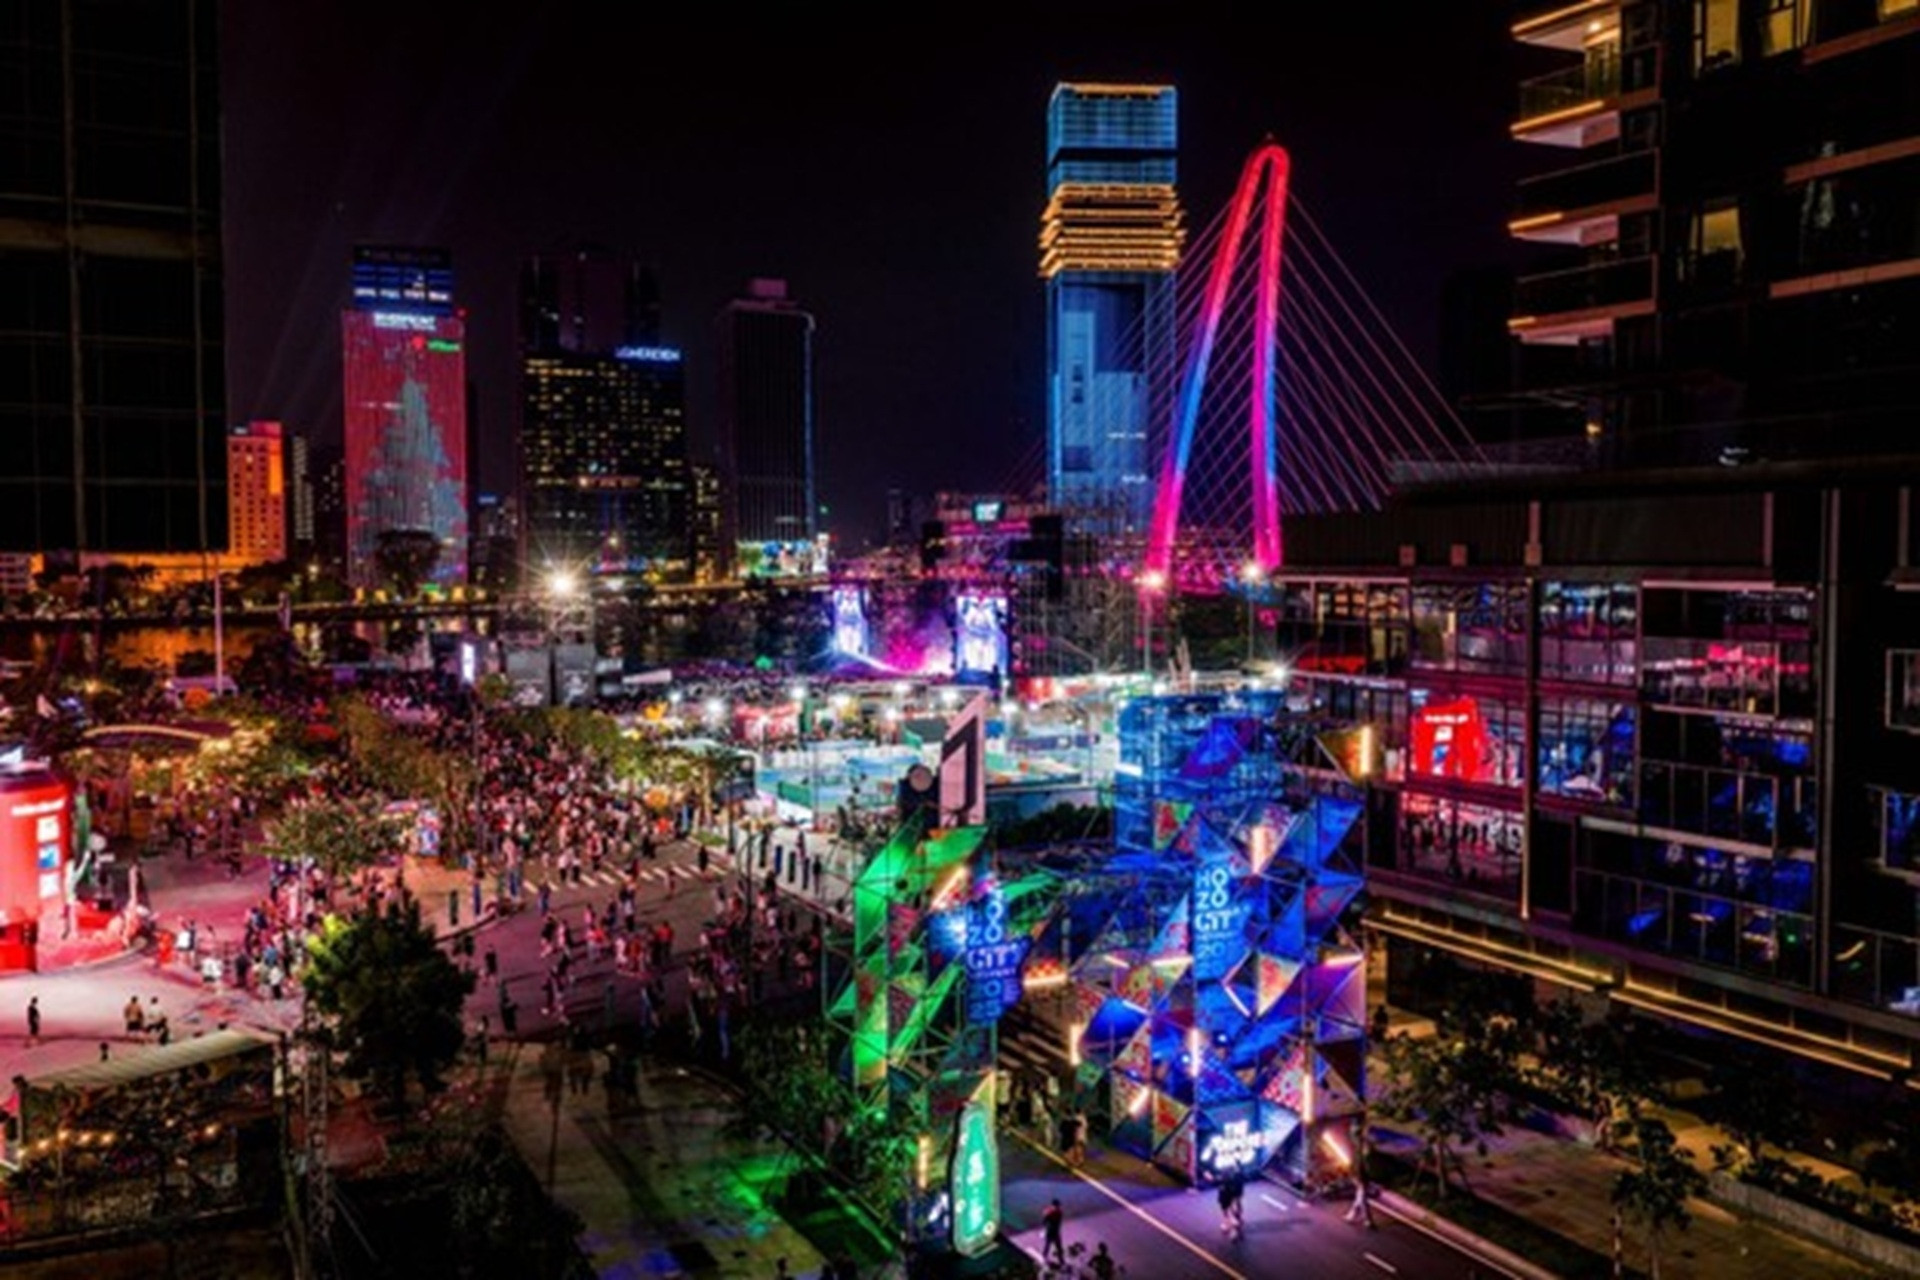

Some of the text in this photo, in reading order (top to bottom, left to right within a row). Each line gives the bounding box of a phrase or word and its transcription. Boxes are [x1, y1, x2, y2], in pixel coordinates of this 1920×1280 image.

[1197, 868, 1229, 888] HO
[1196, 888, 1229, 909] ZO
[968, 922, 1003, 944] ZO
